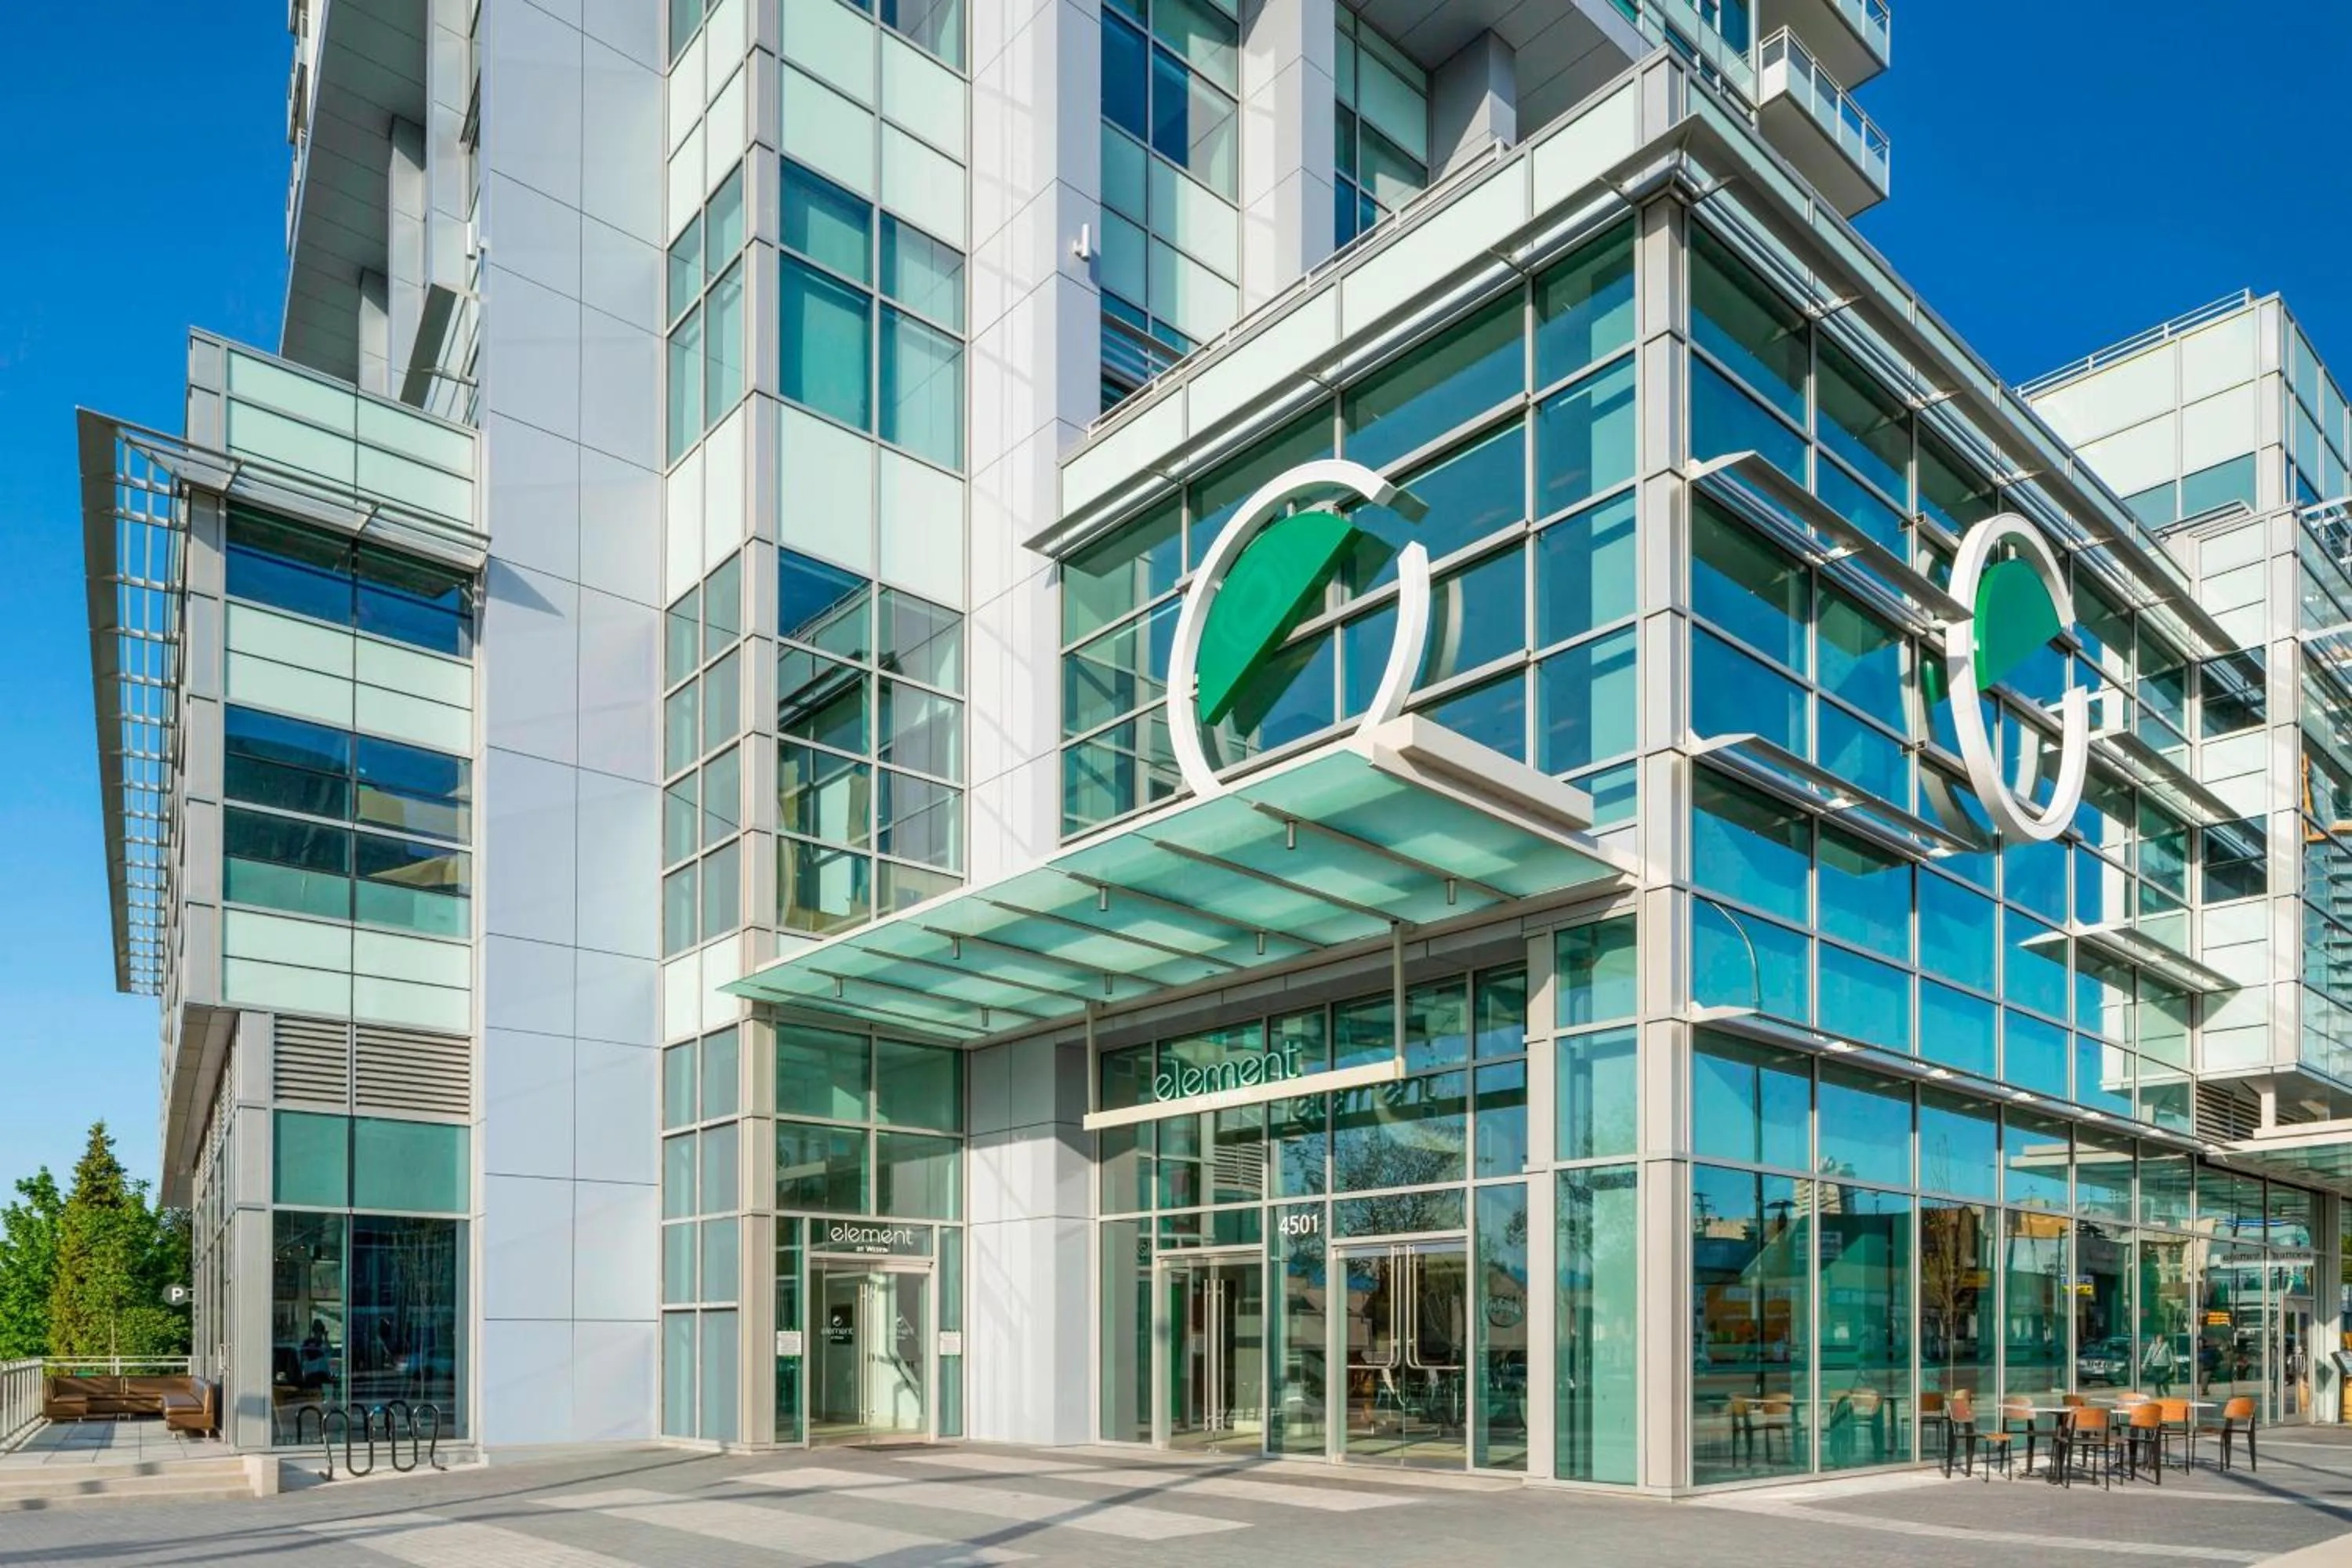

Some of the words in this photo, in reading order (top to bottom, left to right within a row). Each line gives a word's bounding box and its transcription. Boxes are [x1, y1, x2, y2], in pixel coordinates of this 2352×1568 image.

[1154, 1040, 1300, 1101] element
[830, 1222, 914, 1245] element
[1279, 1214, 1318, 1235] 4501
[171, 1287, 184, 1301] P
